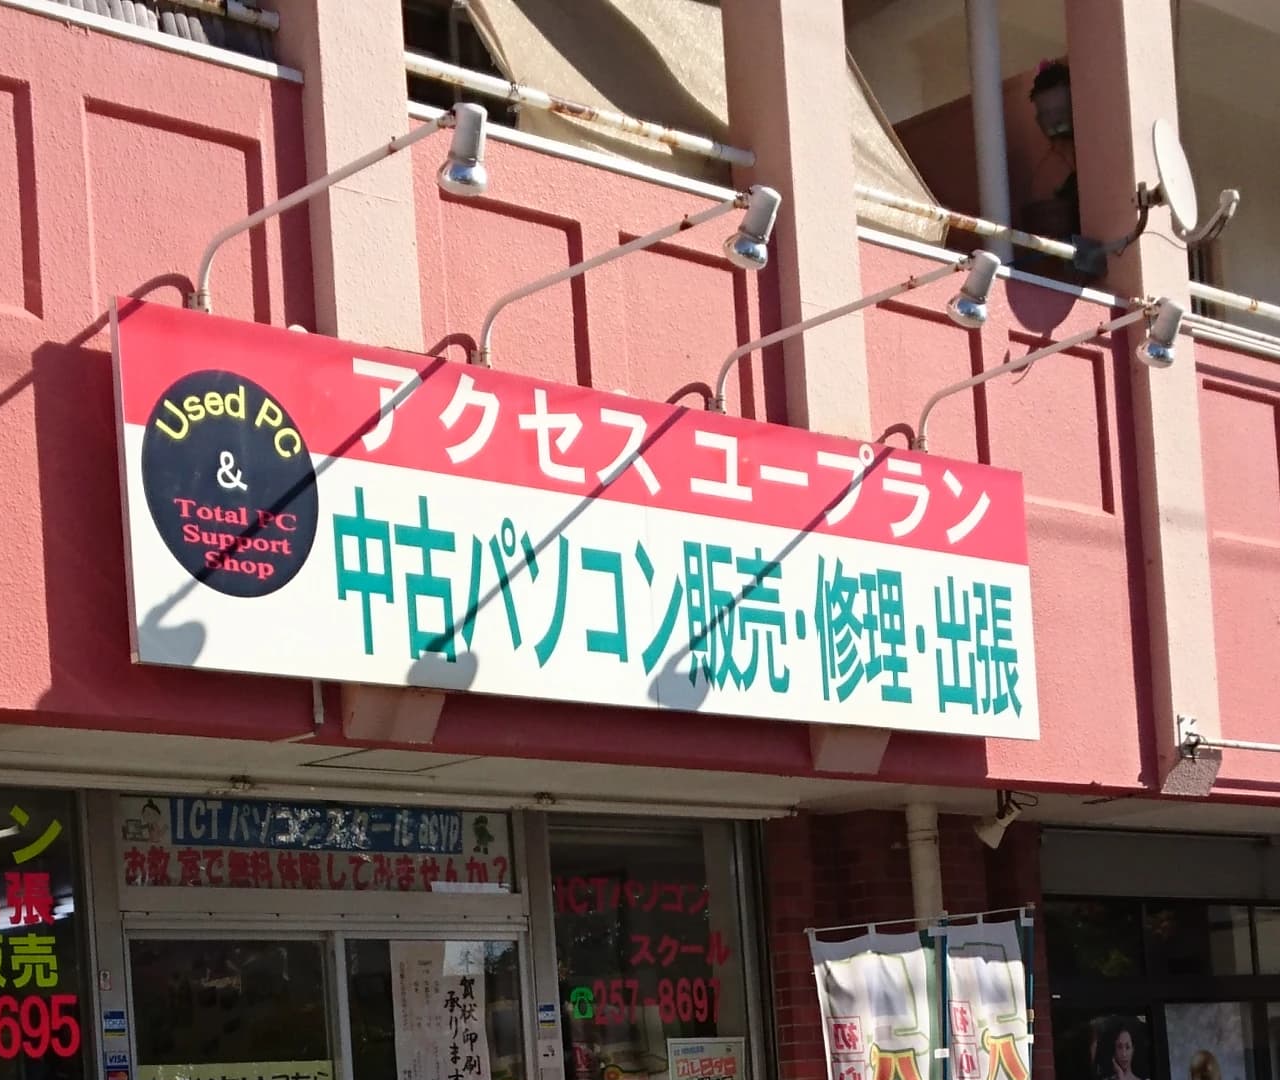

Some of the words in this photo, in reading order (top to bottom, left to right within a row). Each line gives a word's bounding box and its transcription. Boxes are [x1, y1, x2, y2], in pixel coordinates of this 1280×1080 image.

[155, 384, 246, 441] Used
[254, 397, 302, 459] PC
[351, 356, 661, 497] アクセス
[690, 442, 994, 545] ユープラン
[216, 450, 249, 491] &
[172, 497, 249, 526] Total
[256, 509, 297, 532] PC
[181, 523, 293, 556] Support
[203, 550, 275, 581] Shop
[332, 485, 1022, 718] 中古パソコン販売・修理・出張
[629, 930, 732, 967] スクール
[108, 1054, 128, 1064] VISA
